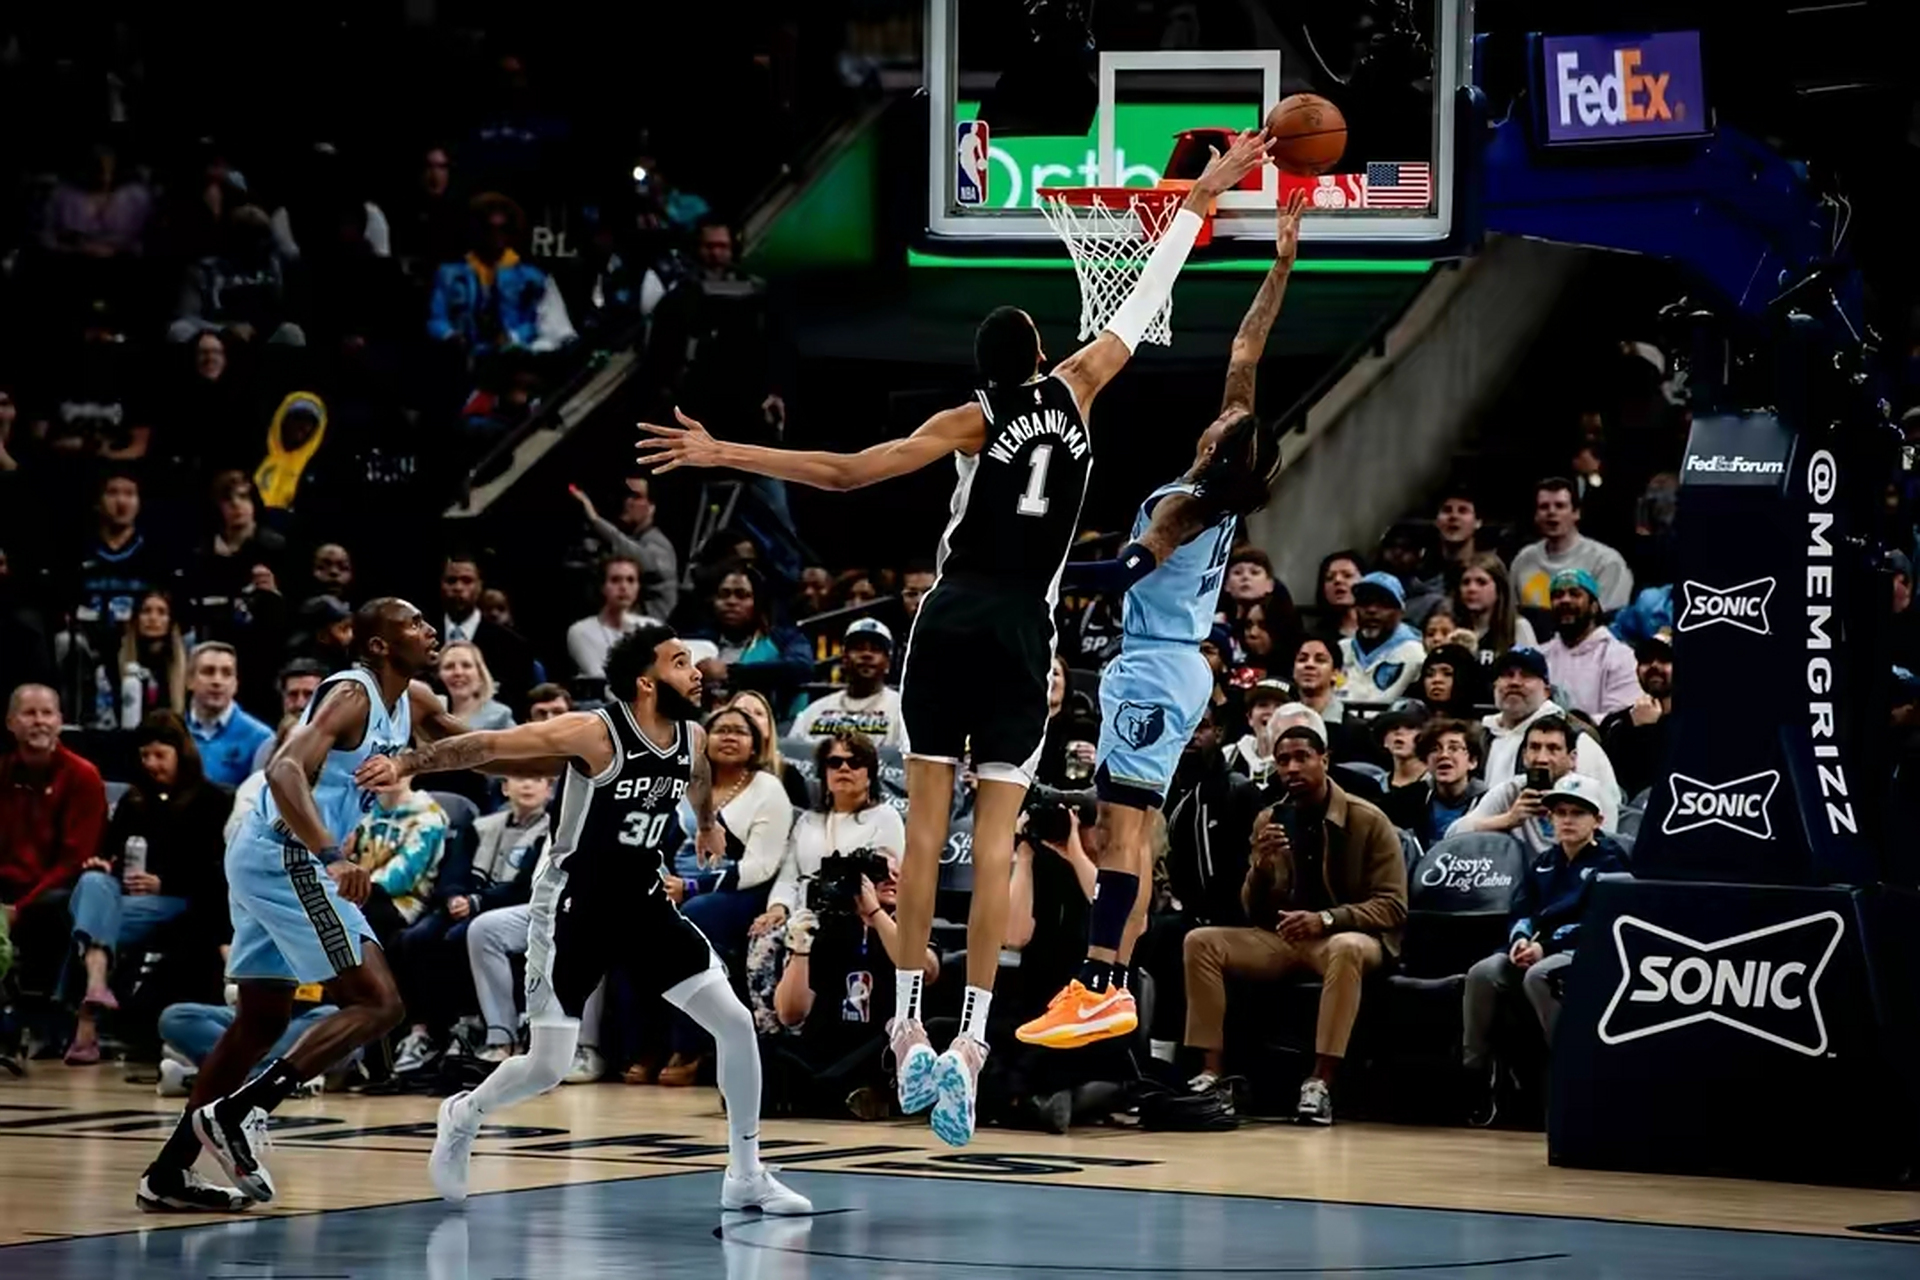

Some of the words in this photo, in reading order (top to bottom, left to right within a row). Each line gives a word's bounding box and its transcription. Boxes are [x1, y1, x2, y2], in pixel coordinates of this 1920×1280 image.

[1557, 48, 1672, 127] FedEx
[1016, 443, 1053, 517] 1
[1690, 595, 1761, 617] SONIC
[1806, 448, 1860, 835] @MEMGRIZZ
[1677, 791, 1761, 818] SONIC
[617, 810, 670, 849] 30
[1421, 852, 1493, 887] Sissy's
[1445, 872, 1473, 894] Log
[1473, 872, 1512, 888] Cabin
[1629, 955, 1807, 1010] SONIC
